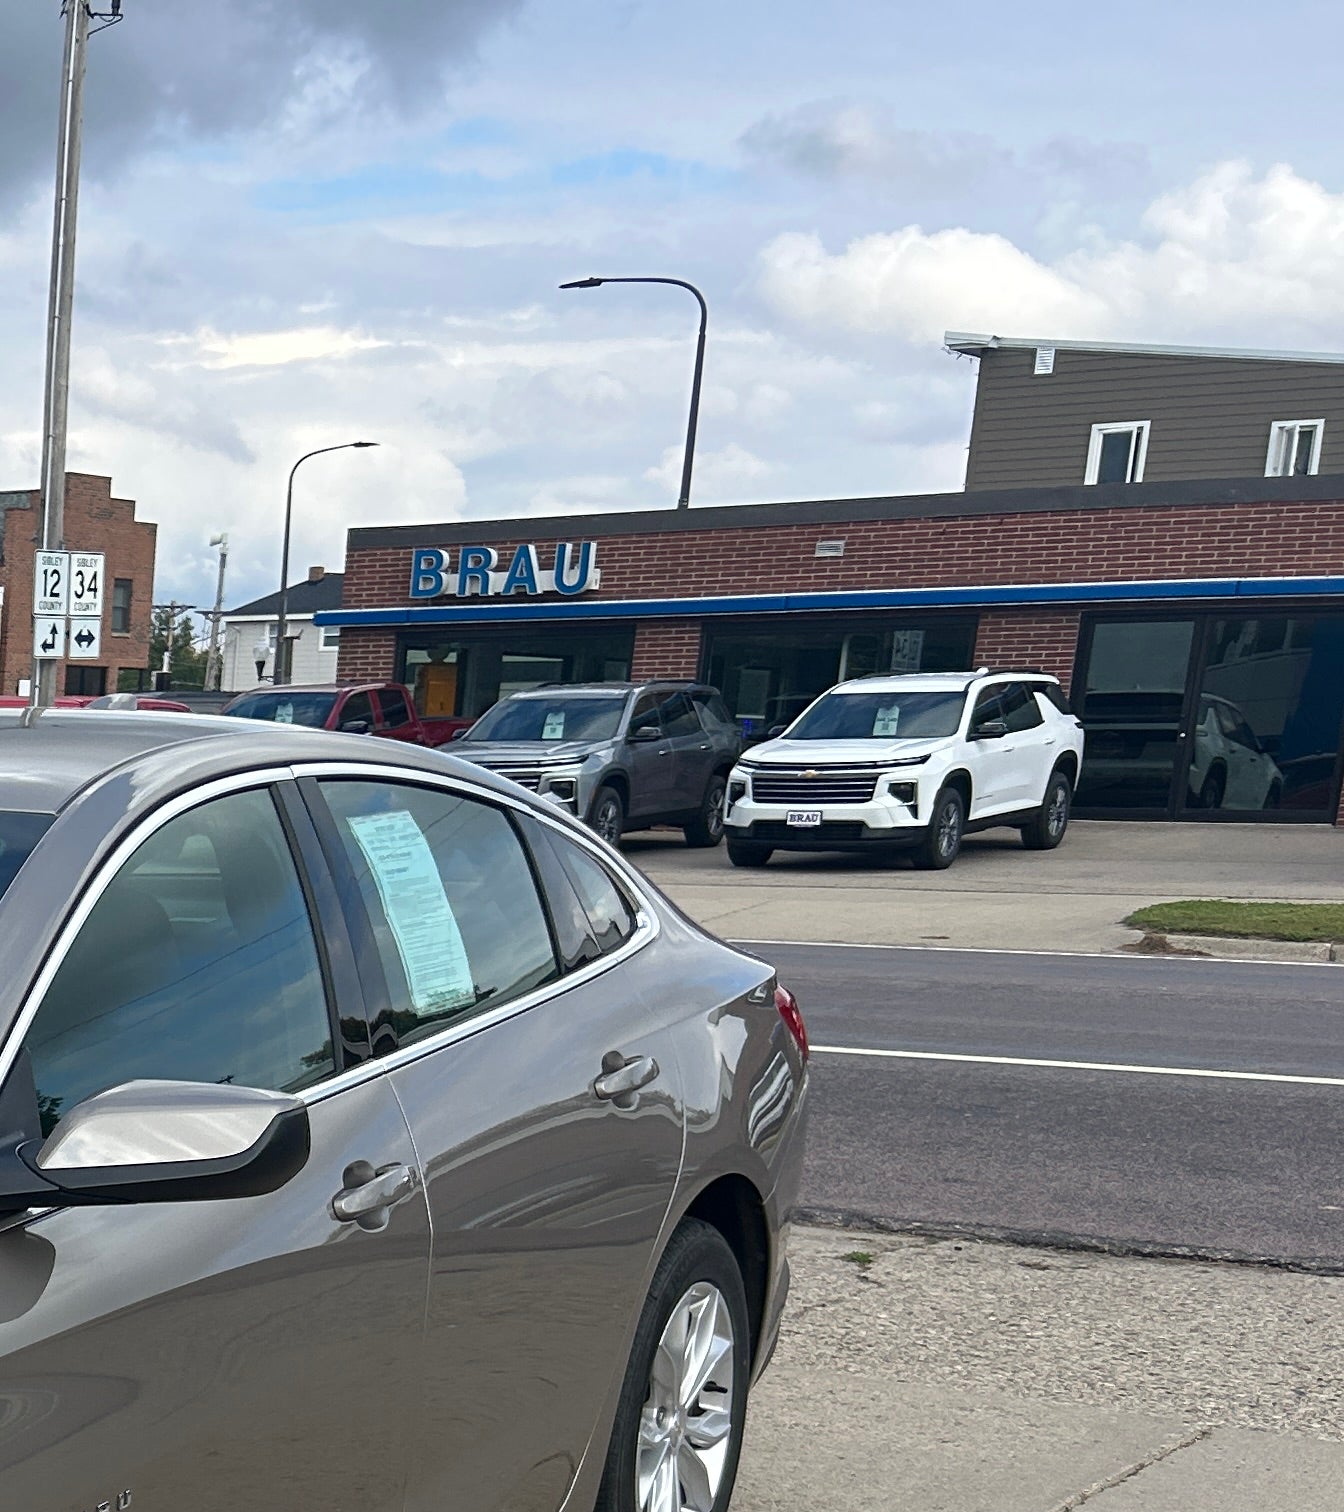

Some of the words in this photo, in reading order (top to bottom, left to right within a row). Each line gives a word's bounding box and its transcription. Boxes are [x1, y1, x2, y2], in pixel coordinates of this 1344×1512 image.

[42, 556, 63, 566] SIBLEY
[76, 558, 98, 568] SIBLEY
[409, 541, 597, 599] BRAU
[43, 569, 61, 598] 12
[74, 570, 98, 600] 34
[39, 601, 63, 611] COUNTY
[74, 602, 98, 611] COUNTY
